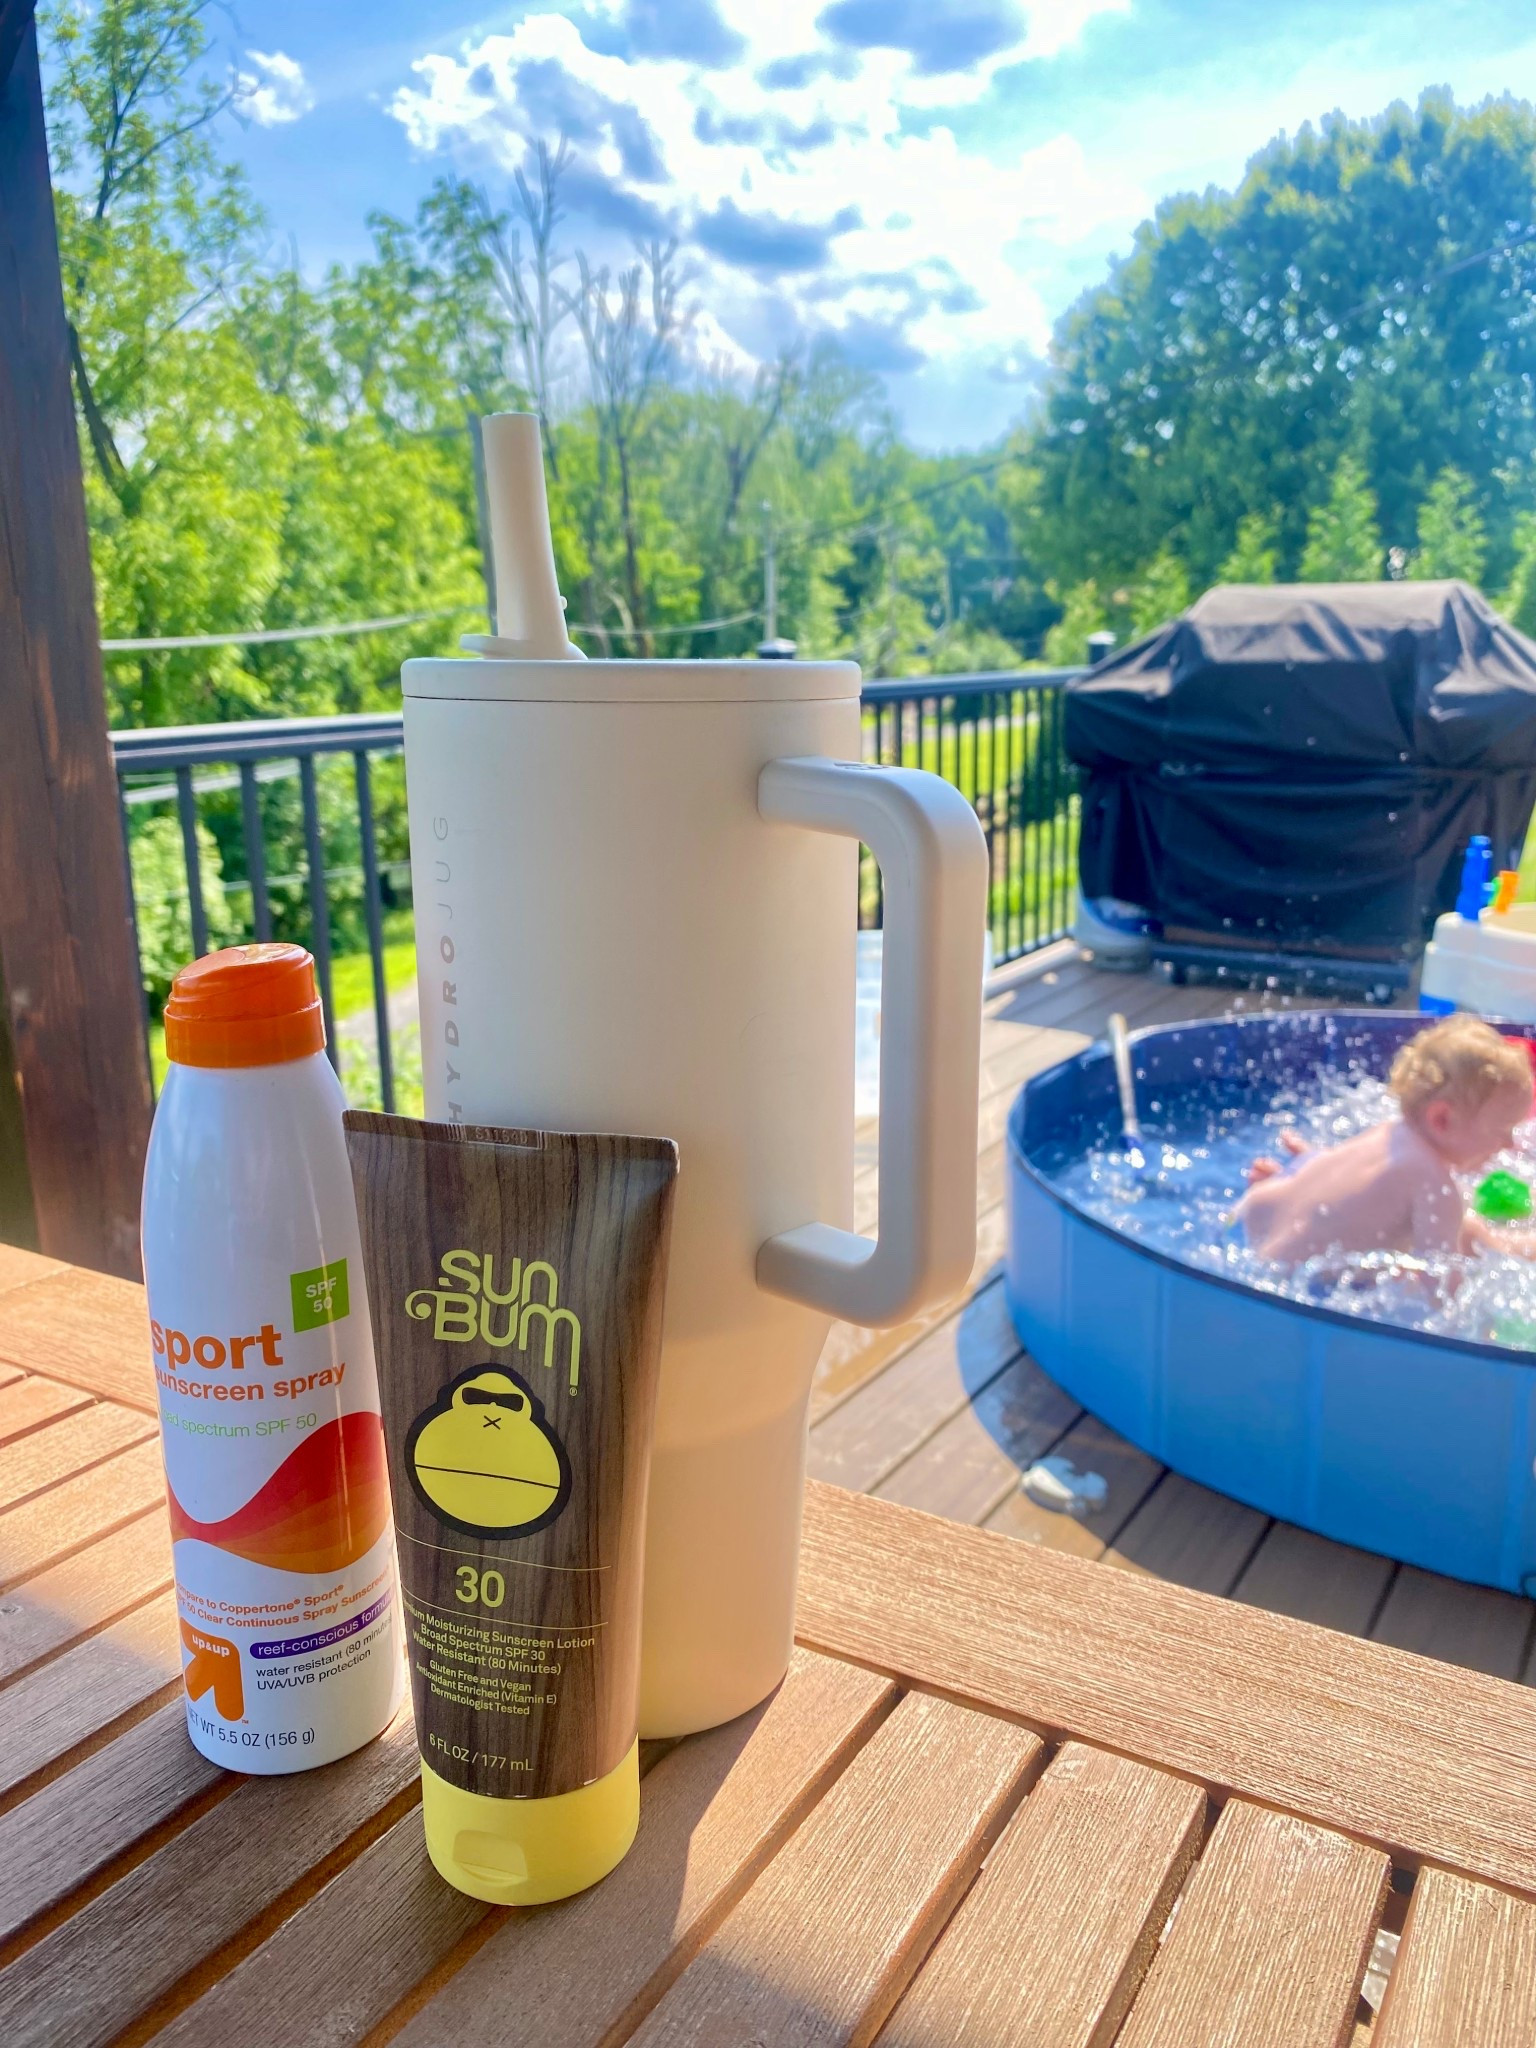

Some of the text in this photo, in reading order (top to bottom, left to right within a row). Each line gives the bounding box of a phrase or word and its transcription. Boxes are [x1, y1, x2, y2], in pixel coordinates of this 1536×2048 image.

[306, 1277, 337, 1298] SPF
[438, 1249, 558, 1308] SUN
[313, 1296, 333, 1313] 50
[151, 1319, 284, 1371] sport
[405, 1289, 581, 1386] BUM
[155, 1362, 346, 1401] sunscreen spray
[182, 1419, 250, 1437] spectrum
[256, 1418, 291, 1437] SPF
[296, 1413, 317, 1430] 50
[207, 1599, 217, 1609] to
[455, 1566, 505, 1608] 30
[197, 1608, 224, 1625] Clear
[226, 1616, 299, 1627] Continuous
[303, 1604, 338, 1621] Spray
[258, 1621, 359, 1655] reef-conscious
[361, 1590, 392, 1624] formul
[426, 1613, 595, 1649] Moisturizing Sunscreen Lotion
[192, 1634, 230, 1657] up&up
[256, 1667, 290, 1677] water
[294, 1650, 342, 1673] resistant
[345, 1640, 361, 1656] (80
[412, 1629, 561, 1675] Water Resistant (80 Minutes)
[421, 1624, 546, 1661] Broad Spectrum SPF 30
[257, 1650, 371, 1690] UVA/UVB protection
[416, 1661, 557, 1705] Antioxidant Enriched (Vitamin E)
[430, 1659, 532, 1692] Gluten Free and Vegan
[430, 1682, 530, 1715] Dermatologist Tested
[201, 1717, 216, 1737] WT
[218, 1728, 238, 1744] 5.5
[242, 1733, 261, 1747] OZ
[265, 1731, 298, 1749] (156
[303, 1728, 315, 1744] g)
[429, 1733, 436, 1746] 6
[437, 1738, 451, 1756] FL
[452, 1744, 470, 1763] OZ
[482, 1753, 507, 1769] 177
[510, 1759, 534, 1771] mL
